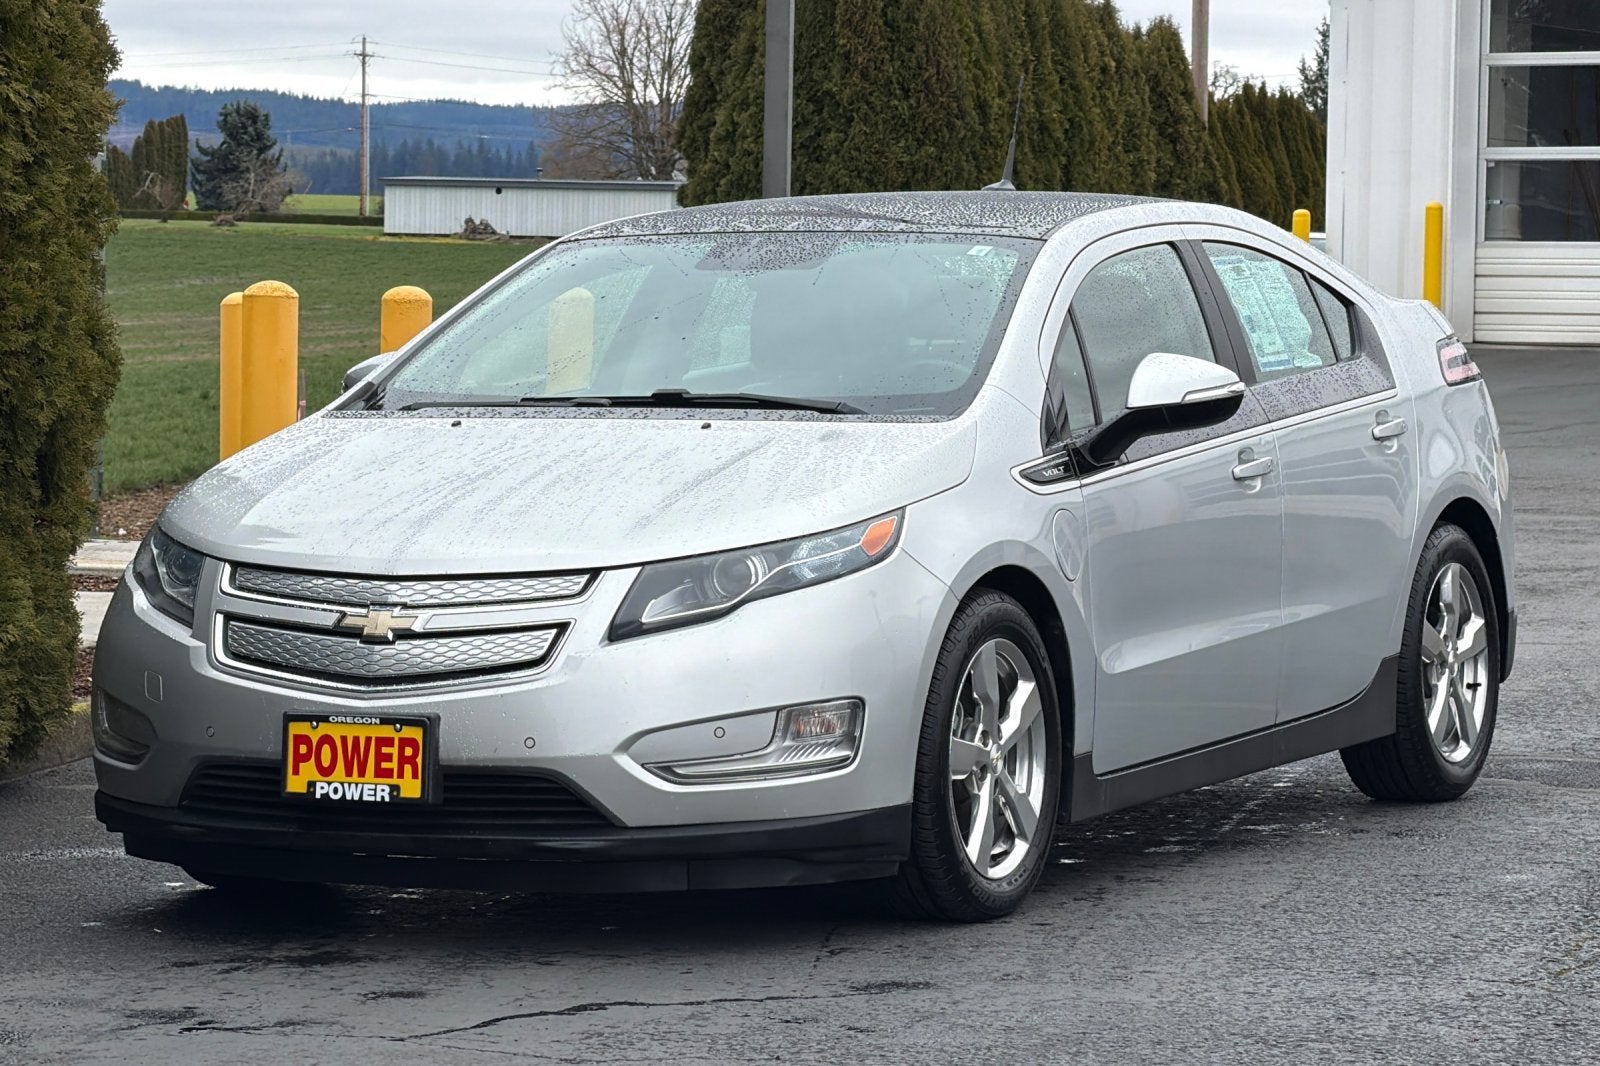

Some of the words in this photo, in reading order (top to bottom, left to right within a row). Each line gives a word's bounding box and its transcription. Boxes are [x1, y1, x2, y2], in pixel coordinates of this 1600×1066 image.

[1043, 466, 1065, 477] VOLT
[329, 716, 380, 724] OREGON
[292, 734, 420, 780] POWER
[315, 782, 390, 802] POWER
